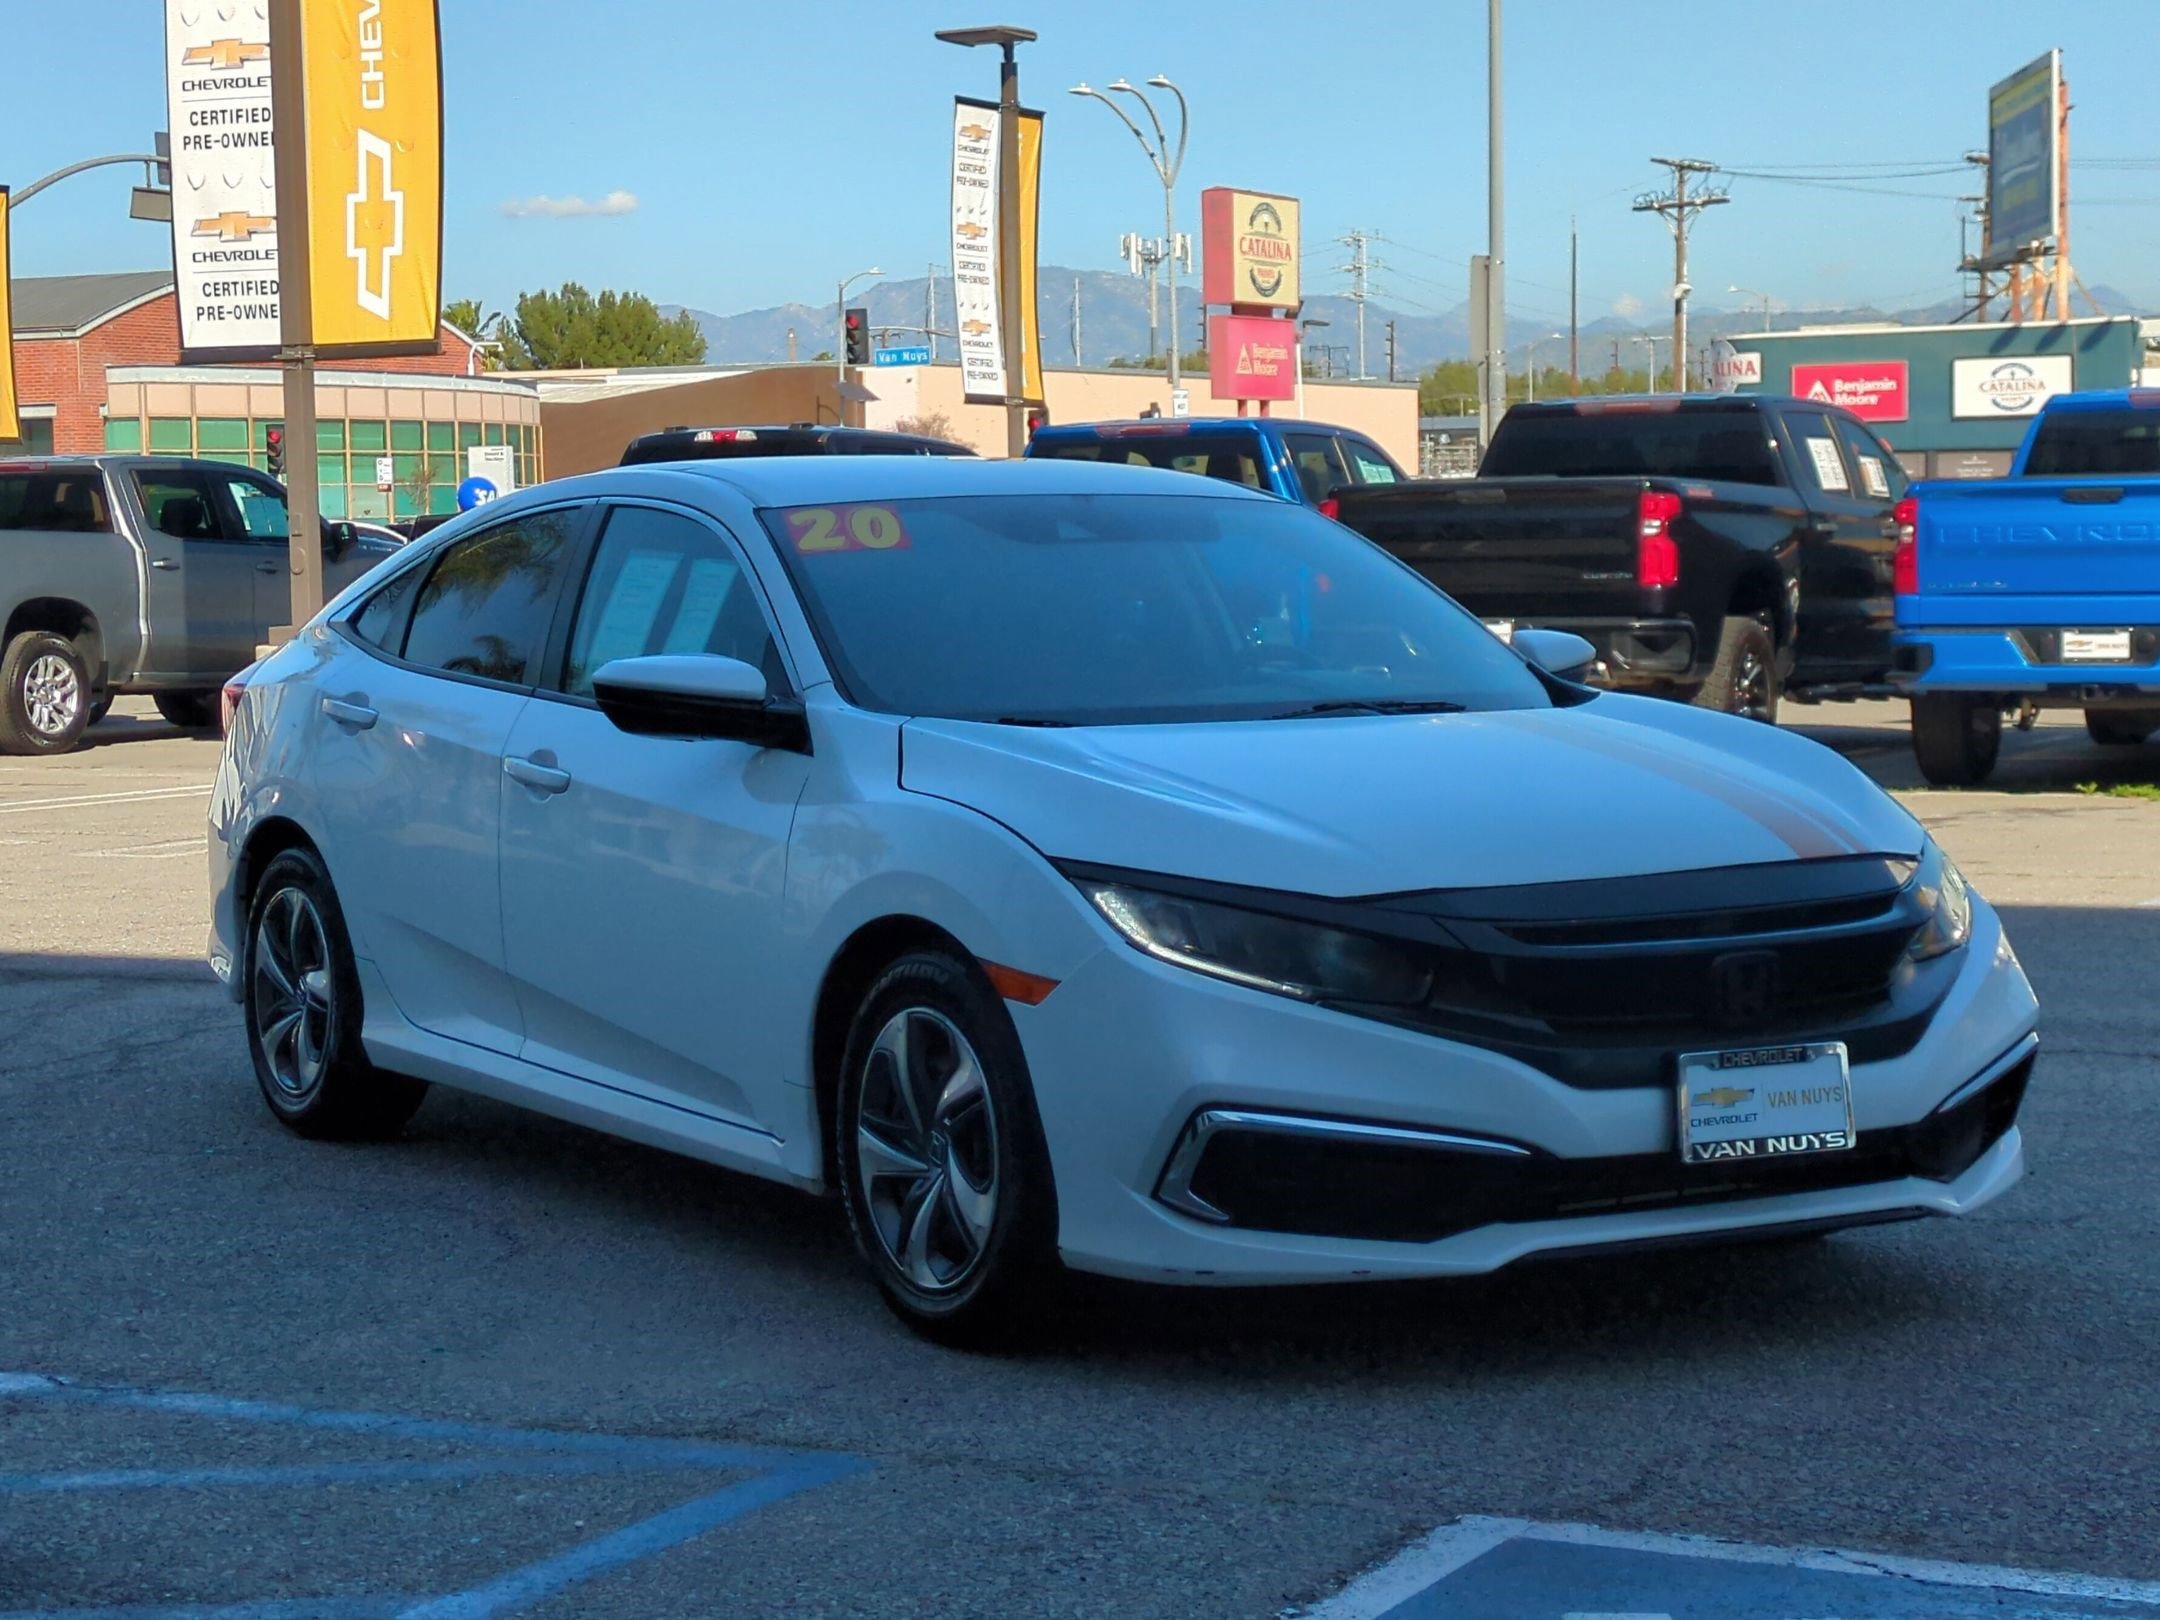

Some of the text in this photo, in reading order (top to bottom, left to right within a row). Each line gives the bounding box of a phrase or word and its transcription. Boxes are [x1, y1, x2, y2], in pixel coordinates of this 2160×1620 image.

[182, 76, 271, 92] CHEVROLE
[189, 107, 271, 126] CERTIFIED
[182, 131, 275, 150] PRE-OWNE
[191, 248, 279, 264] CHEVROLE
[1239, 236, 1292, 262] CATALINA
[201, 279, 280, 298] CERTIFIED
[878, 351, 928, 363] Van Nuys
[1834, 377, 1898, 396] Benjamin
[1979, 380, 2047, 393] CATALINA
[1834, 392, 1879, 406] Moore
[788, 506, 901, 551] 20
[1722, 1047, 1803, 1068] CHEVROLET
[1767, 1086, 1843, 1109] VAN NUYS
[1690, 1112, 1759, 1128] CHEVROLET
[1694, 1131, 1847, 1160] VAN NUYS
